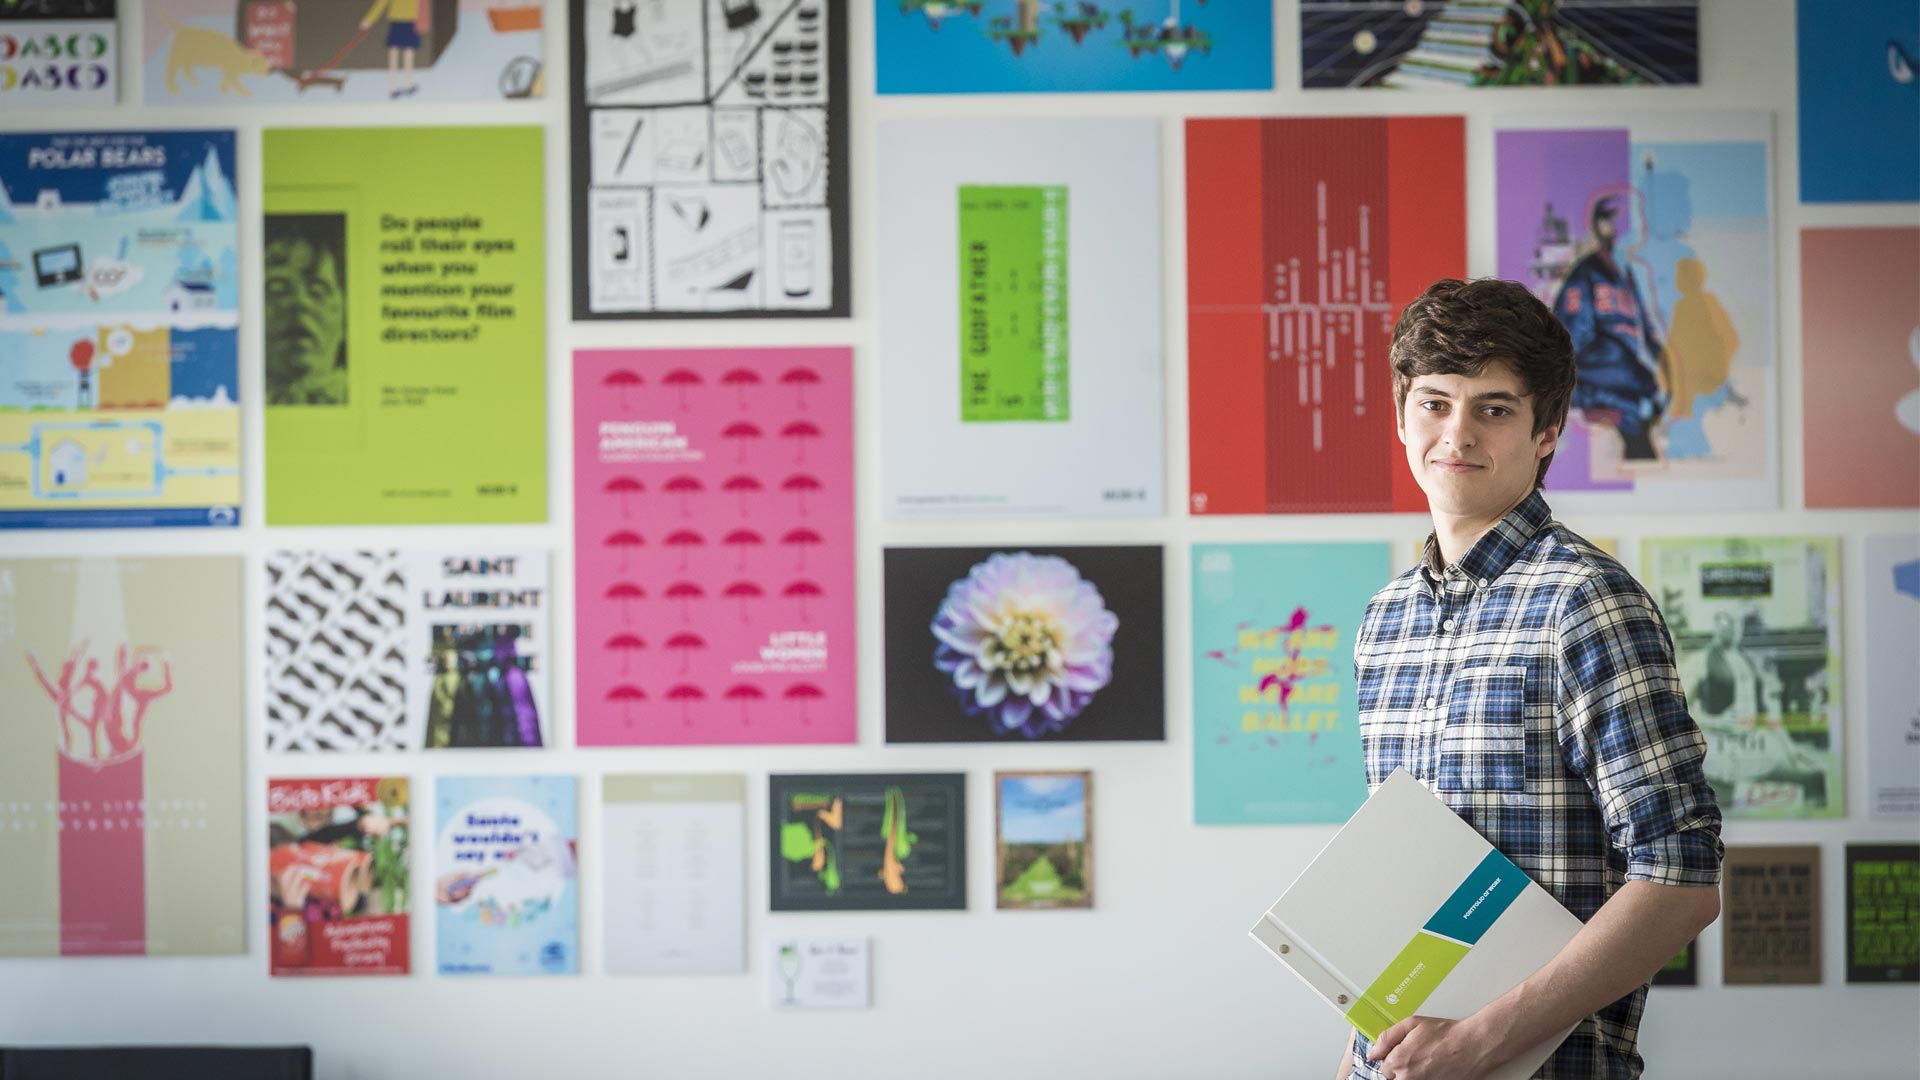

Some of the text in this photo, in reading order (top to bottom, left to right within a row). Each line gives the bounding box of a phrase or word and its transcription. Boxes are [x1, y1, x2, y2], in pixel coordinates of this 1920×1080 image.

[29, 145, 166, 169] POLAR BEARS
[381, 214, 482, 234] Do people
[381, 238, 515, 257] roll their eyes
[382, 261, 478, 278] when you
[382, 284, 514, 300] mention your
[382, 303, 515, 319] favourite film
[970, 241, 989, 406] THE GODFATHER
[442, 556, 519, 577] SAINT
[422, 588, 541, 609] LAURENT
[1238, 630, 1278, 650] WE
[1287, 682, 1340, 705] ARE
[1463, 877, 1502, 919] PORTFOLIO OF WORK
[1394, 976, 1411, 994] OLIVER
